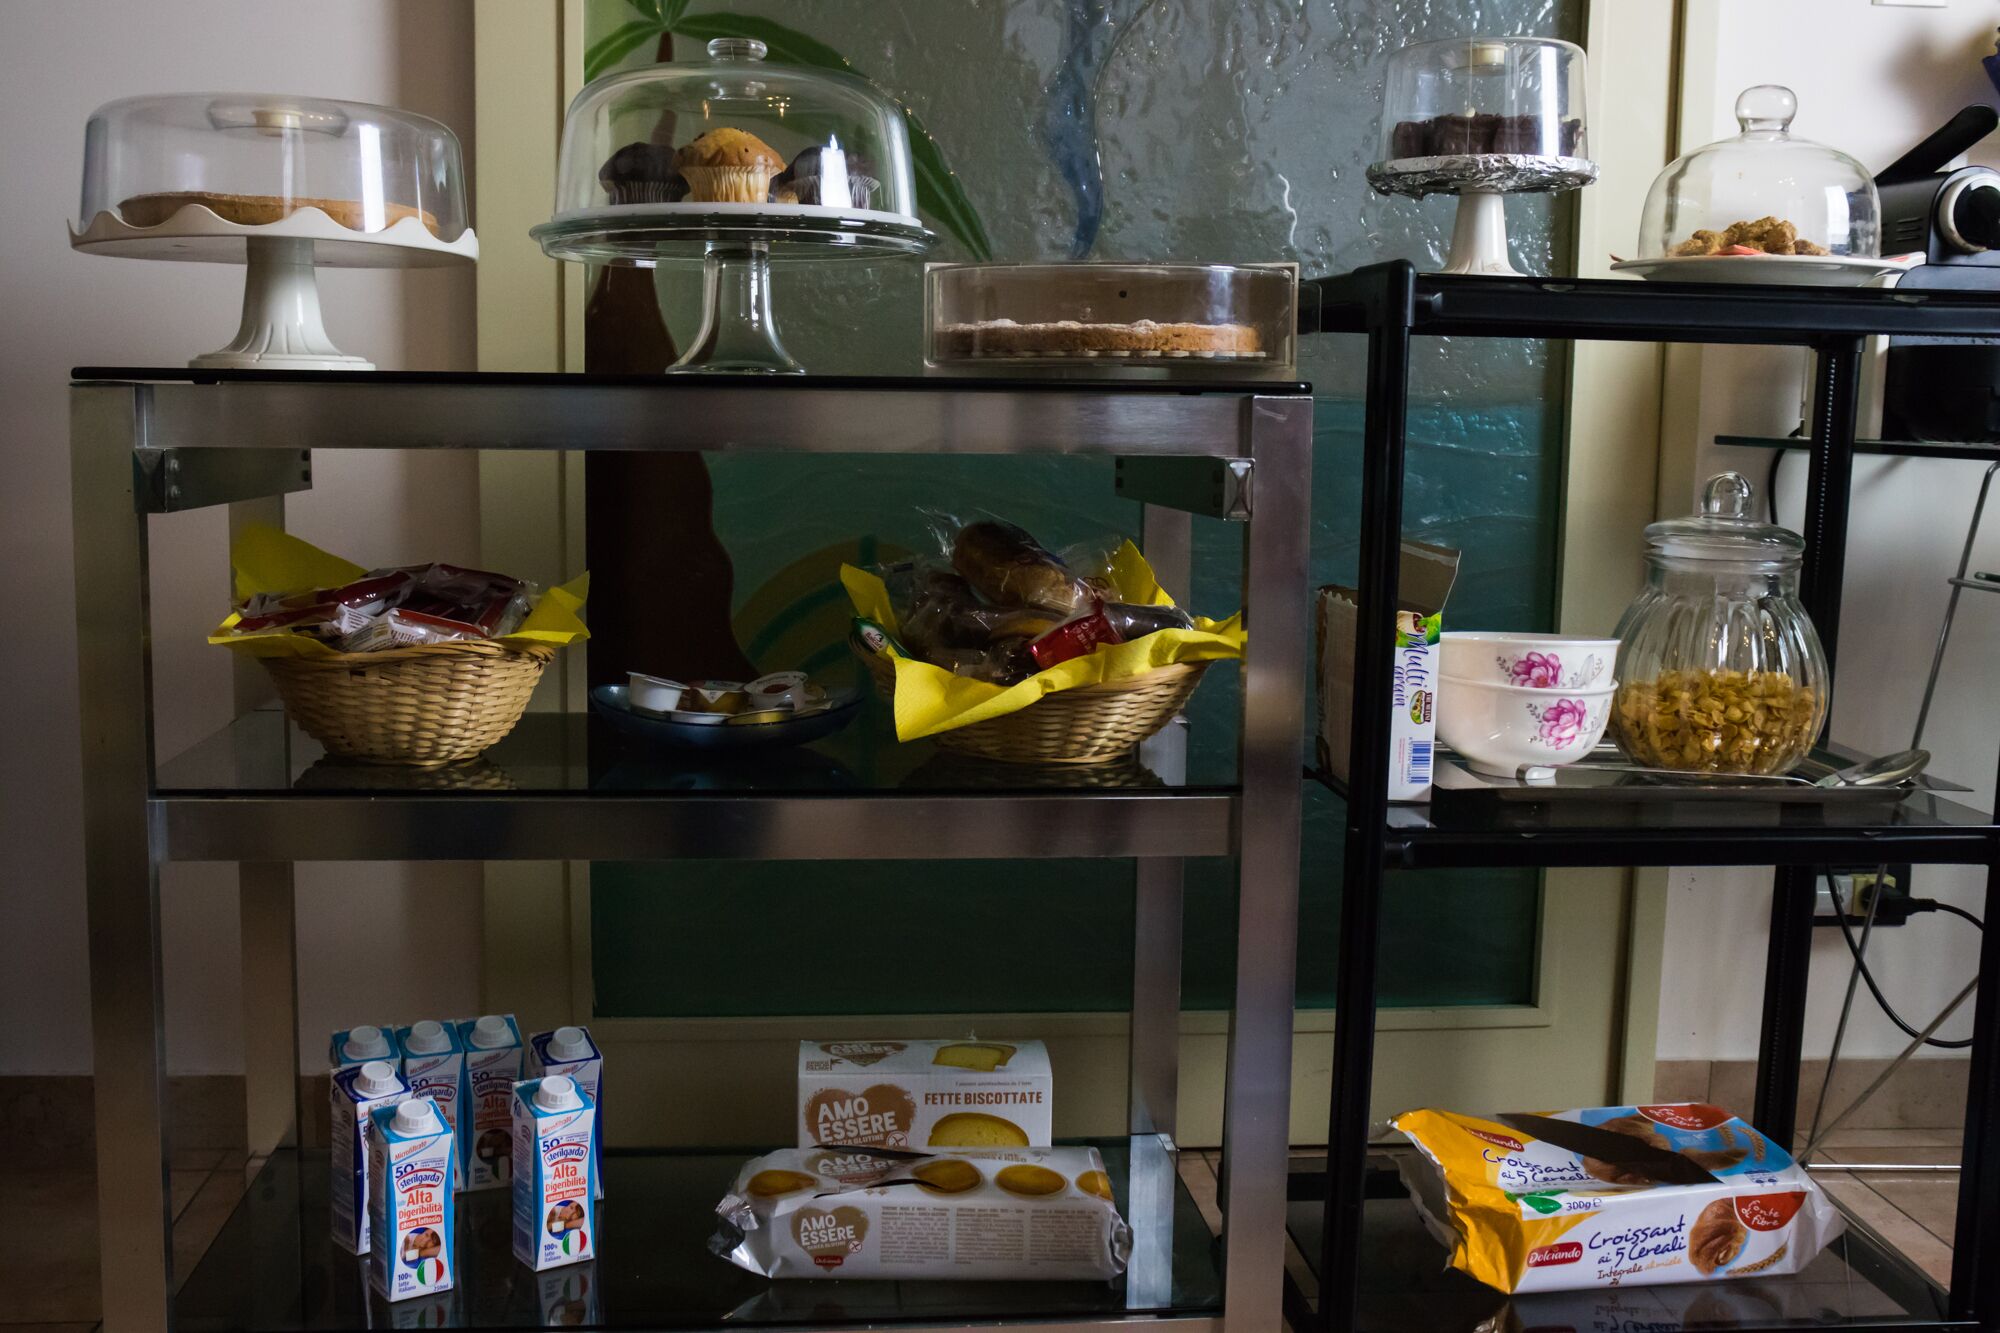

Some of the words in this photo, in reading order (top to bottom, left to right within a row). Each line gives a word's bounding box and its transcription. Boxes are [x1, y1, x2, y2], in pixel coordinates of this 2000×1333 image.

[1404, 632, 1429, 688] Multi
[925, 1092, 961, 1105] FETTE
[964, 1091, 1043, 1105] BISCOTTATE
[475, 1109, 513, 1122] Digeribilit
[818, 1097, 869, 1122] AMO
[818, 1111, 898, 1143] ESSERE
[547, 1147, 584, 1162] sterilgarda
[818, 1154, 872, 1166] AMO
[1483, 1149, 1580, 1173] Croissant
[400, 1172, 440, 1189] sterilgarda
[553, 1164, 577, 1181] Alta
[1502, 1171, 1515, 1180] ai
[1517, 1171, 1529, 1184] 5
[545, 1176, 586, 1193] Digeribilità
[407, 1190, 433, 1207] Alta
[1566, 1201, 1592, 1211] 300g
[399, 1203, 443, 1219] Digeribilità
[1748, 1200, 1780, 1218] Fonte
[800, 1215, 836, 1232] AMO
[1751, 1215, 1780, 1227] fibre
[800, 1225, 855, 1246] ESSERE
[1588, 1214, 1686, 1249] Croissant
[1528, 1248, 1582, 1264] Dolciando
[1598, 1252, 1611, 1265] ai
[1613, 1248, 1626, 1267] 5
[1628, 1236, 1687, 1261] Cereali
[1597, 1263, 1643, 1281] Integrale
